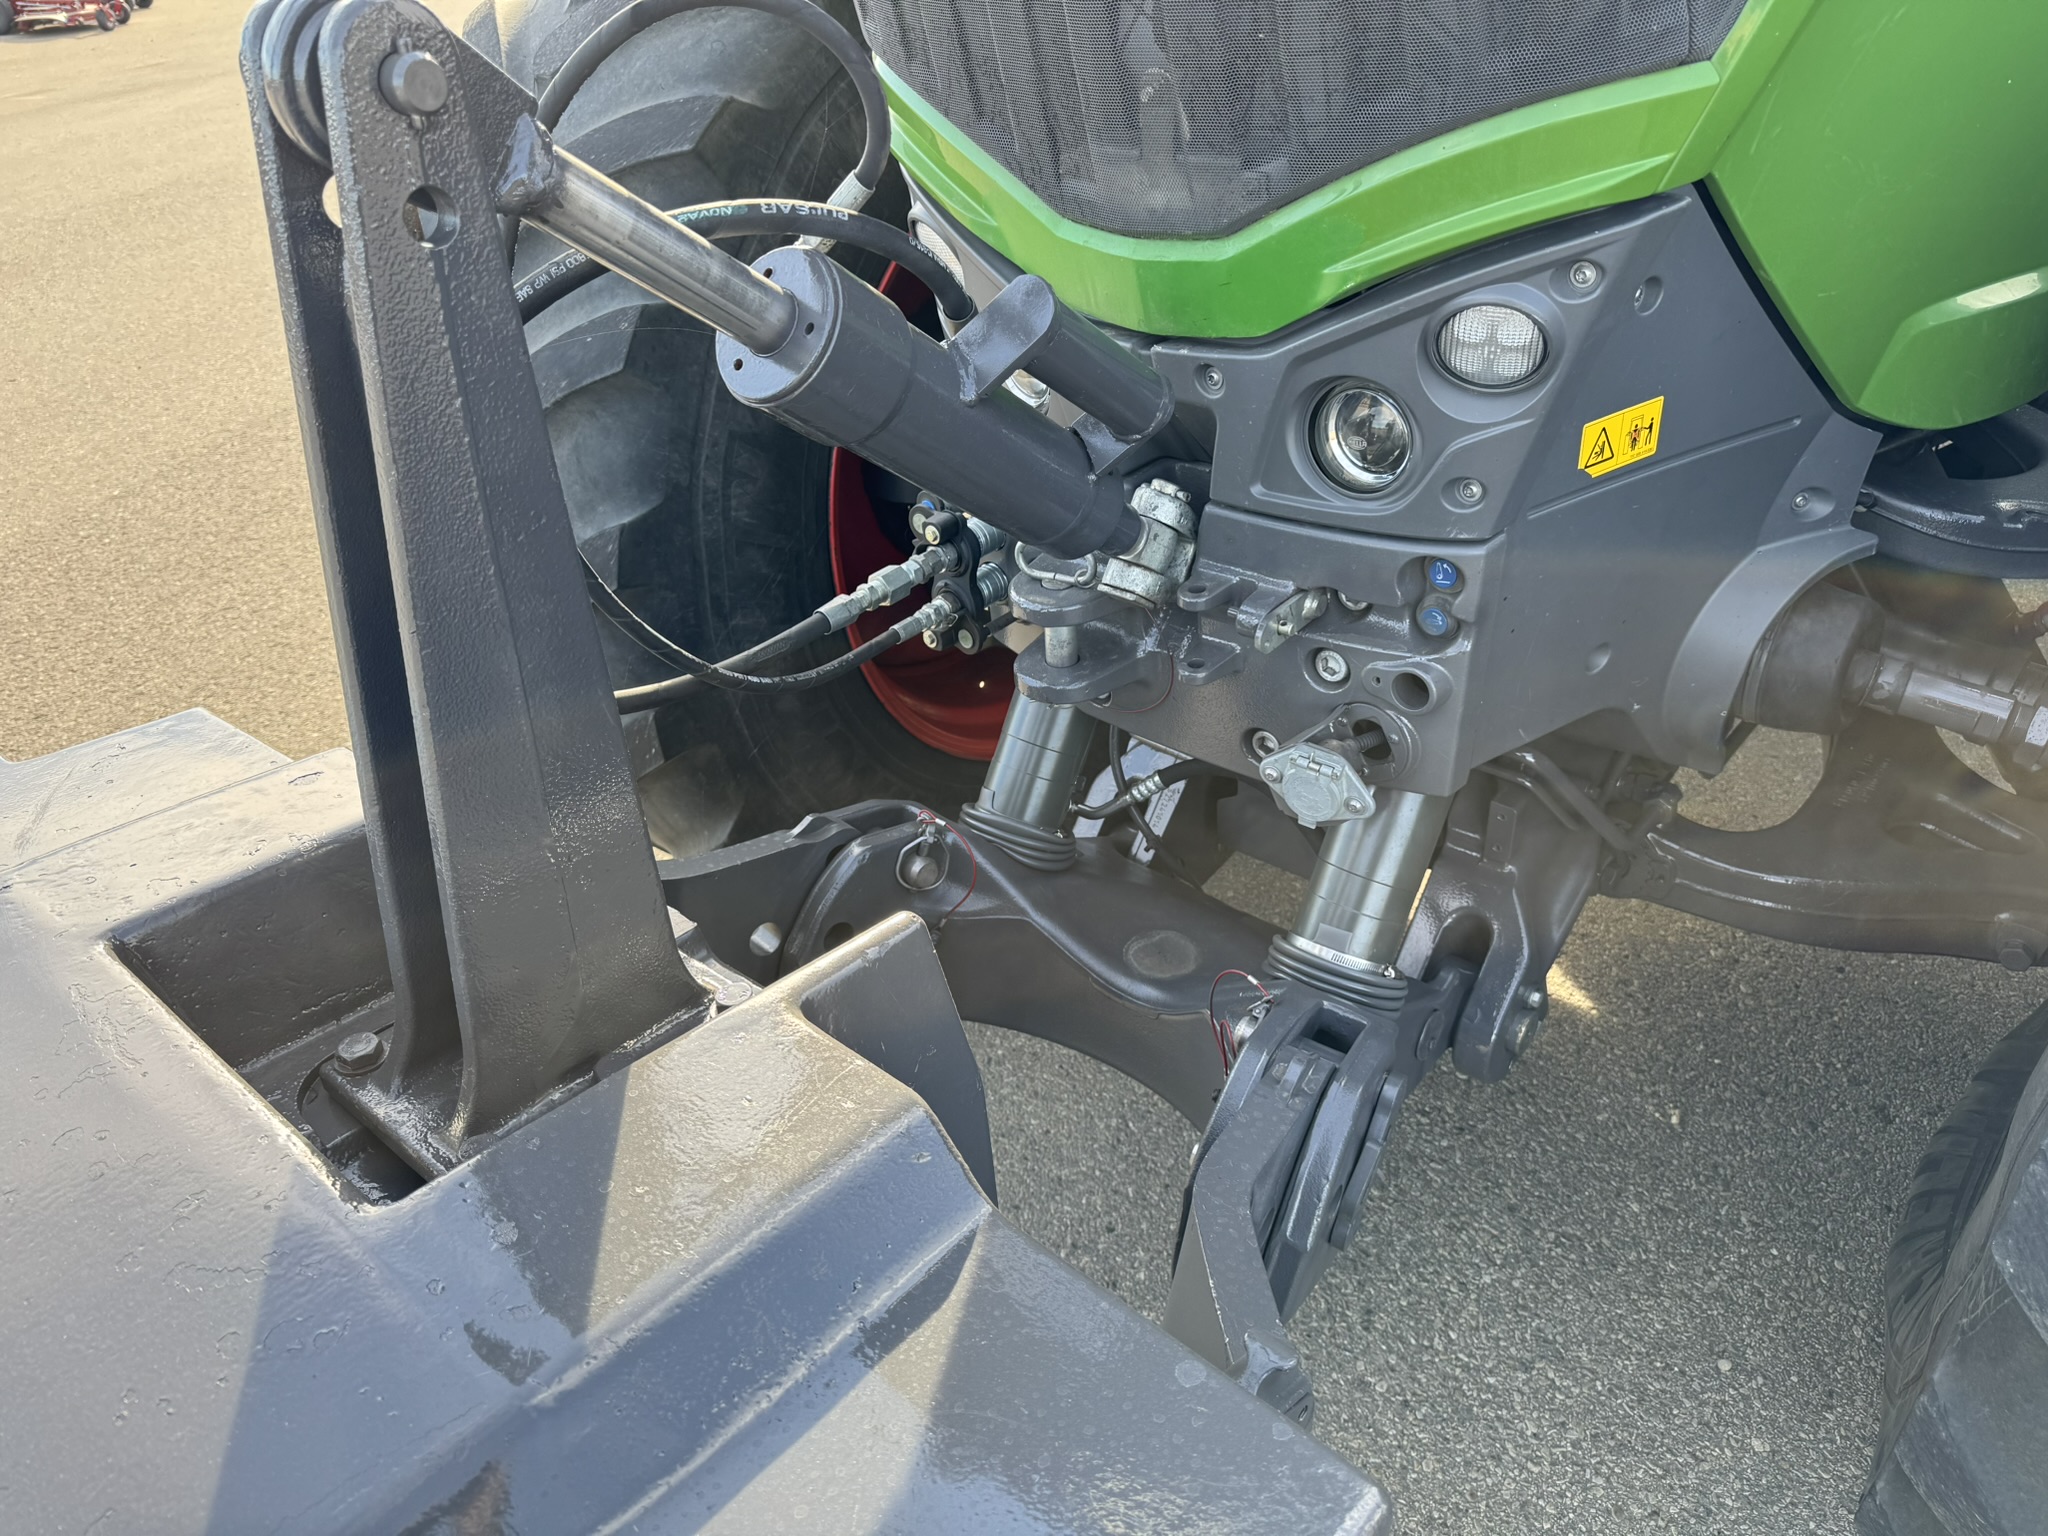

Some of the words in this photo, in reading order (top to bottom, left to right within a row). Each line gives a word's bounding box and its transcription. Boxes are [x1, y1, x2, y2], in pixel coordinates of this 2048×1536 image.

[565, 252, 590, 269] 800
[549, 263, 567, 279] PSI
[534, 273, 551, 289] WP
[514, 285, 534, 303] SAE
